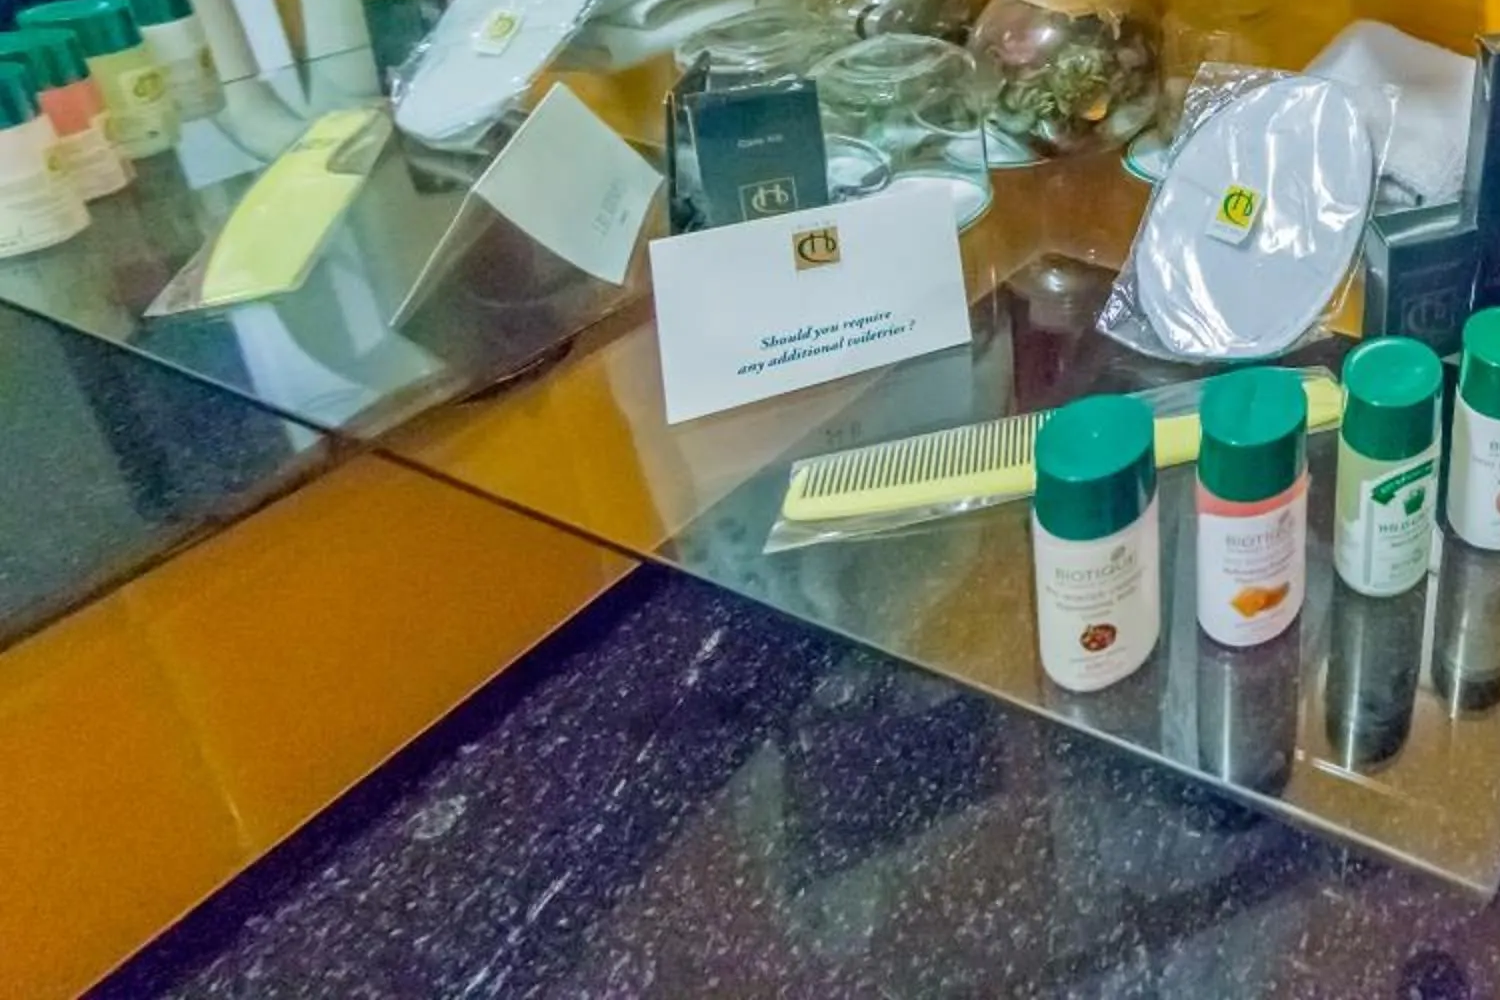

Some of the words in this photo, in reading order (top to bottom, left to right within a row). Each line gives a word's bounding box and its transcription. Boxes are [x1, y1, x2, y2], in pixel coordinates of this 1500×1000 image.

[759, 325, 812, 350] Should
[813, 323, 840, 341] you
[843, 311, 892, 329] require
[737, 361, 765, 376] any
[767, 336, 844, 368] additional
